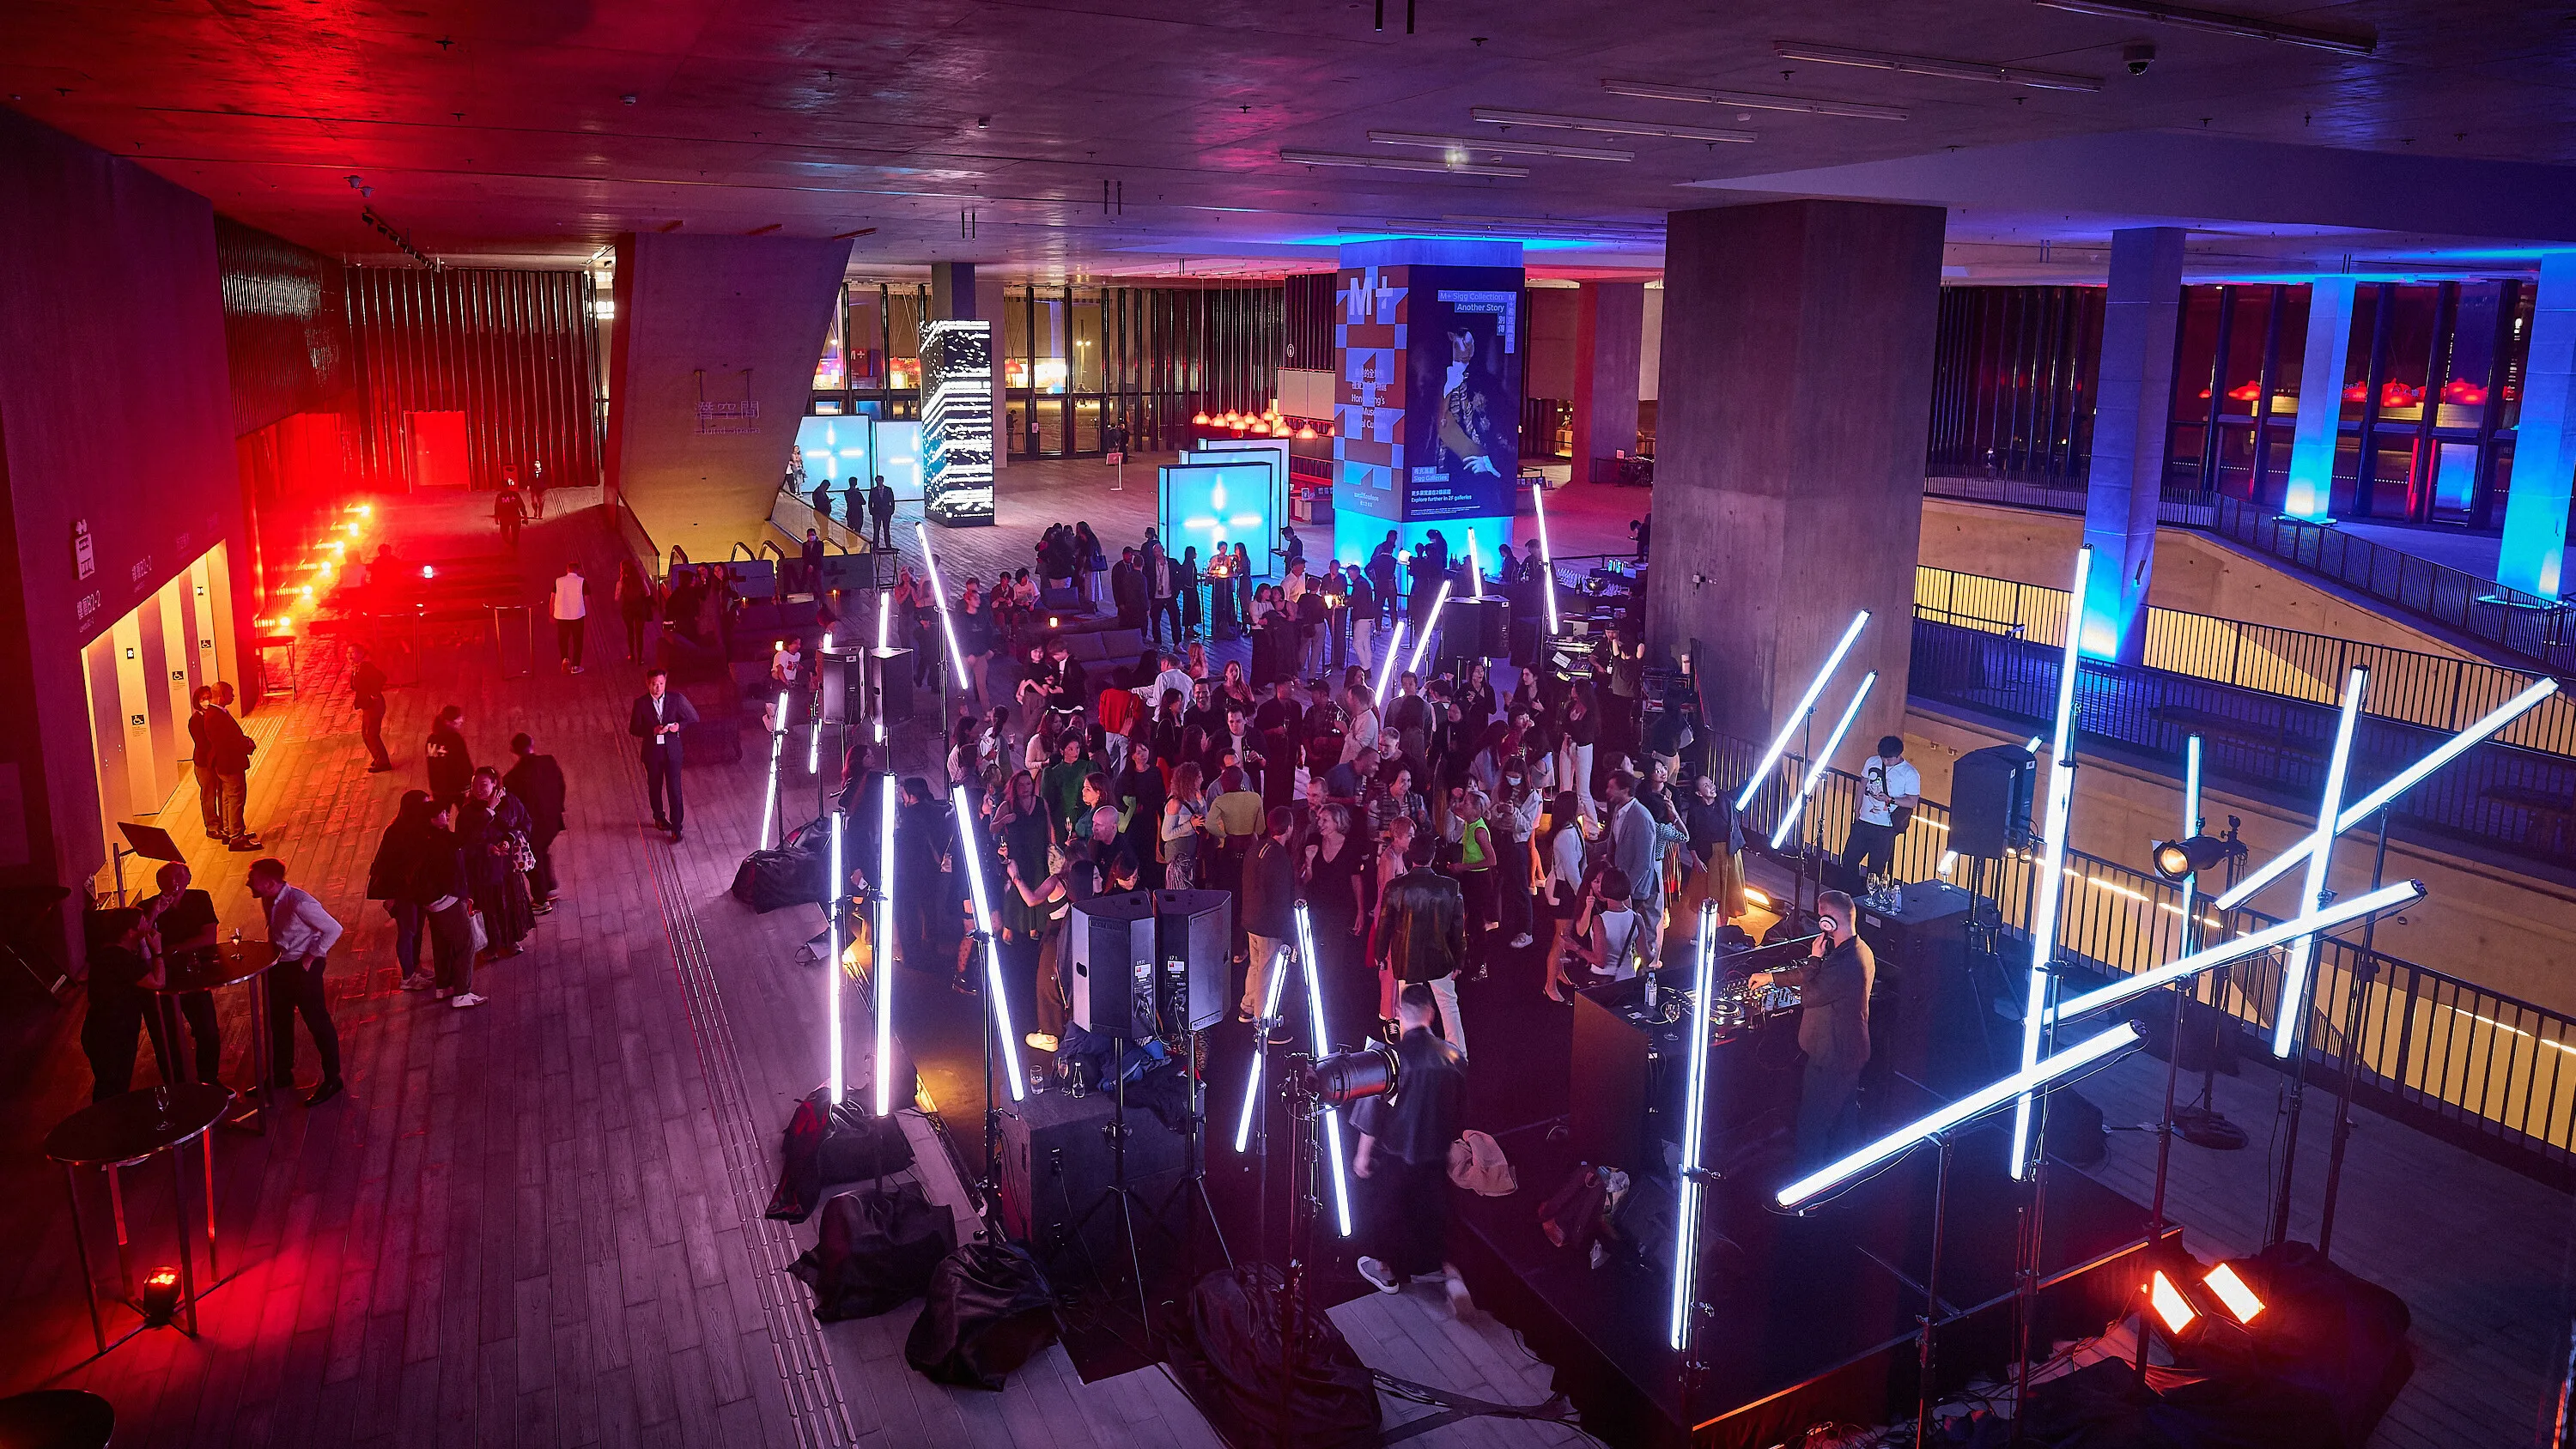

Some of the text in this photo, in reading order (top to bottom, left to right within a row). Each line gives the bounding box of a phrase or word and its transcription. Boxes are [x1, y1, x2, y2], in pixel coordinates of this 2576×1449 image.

[1349, 276, 1393, 315] M+
[1454, 293, 1467, 301] Sigg
[1486, 303, 1504, 312] Story
